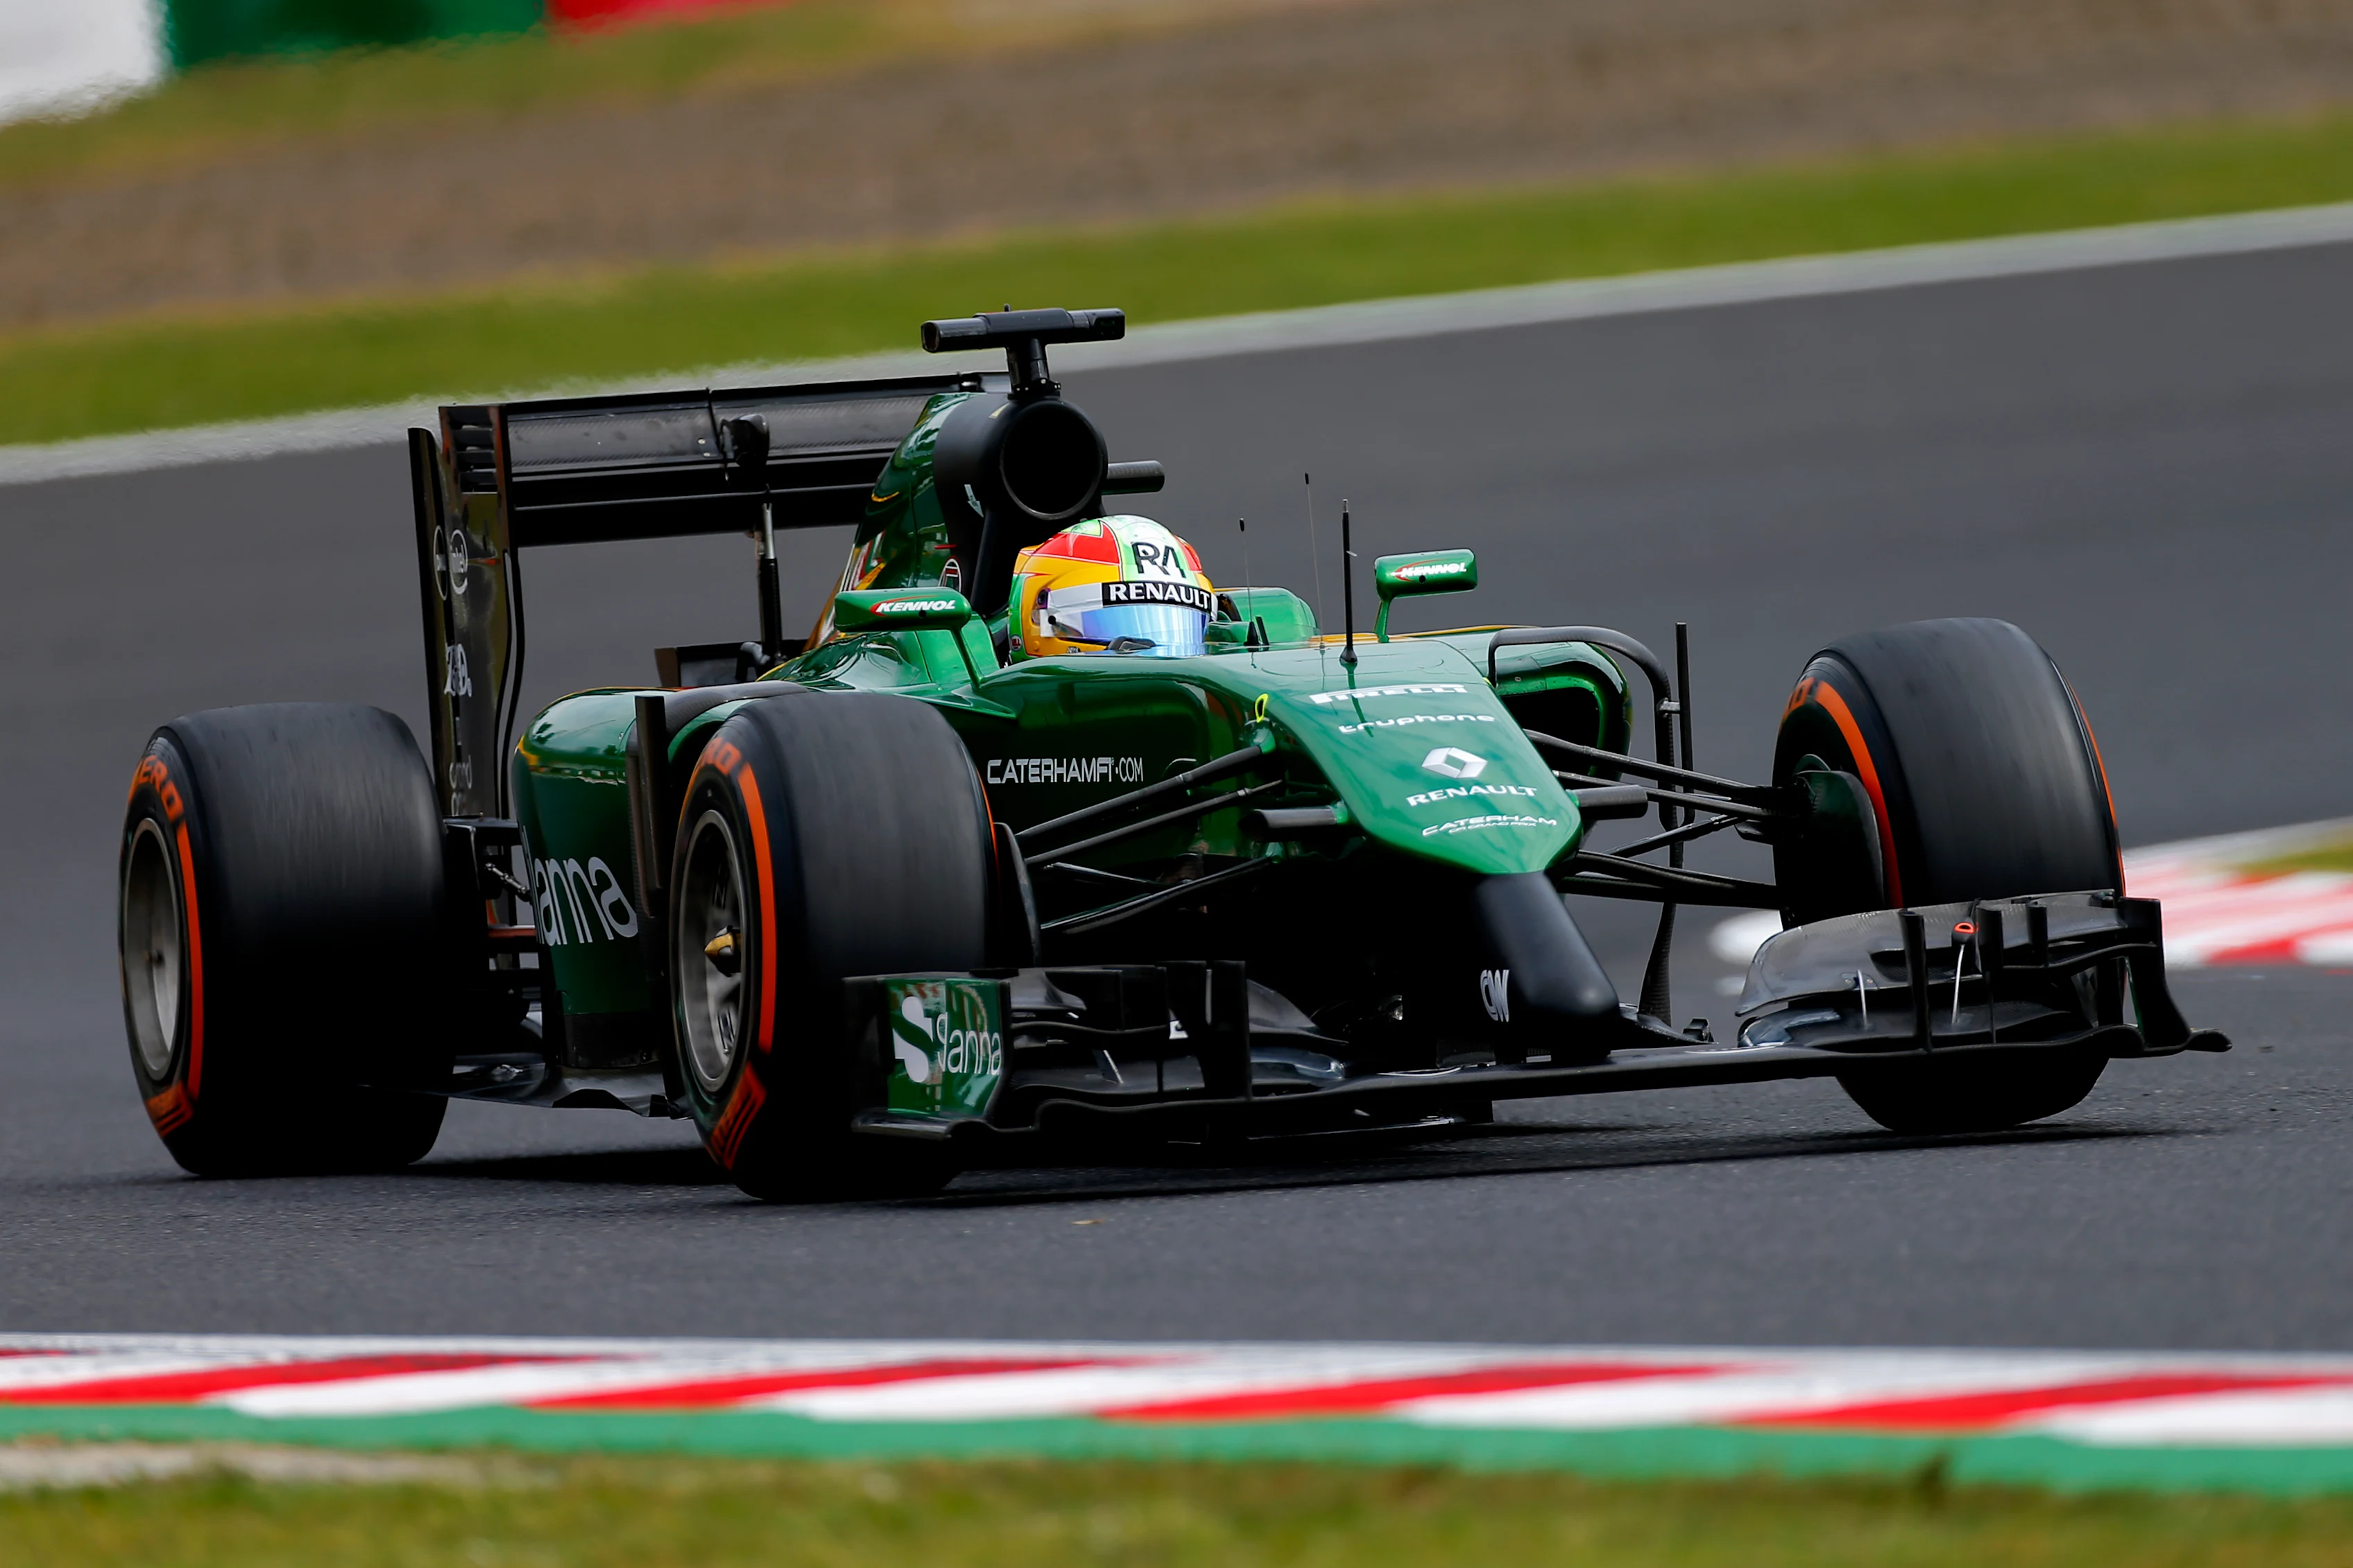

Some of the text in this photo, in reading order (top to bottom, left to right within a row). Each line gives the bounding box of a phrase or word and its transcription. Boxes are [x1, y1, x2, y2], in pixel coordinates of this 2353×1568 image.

[1400, 562, 1467, 578] KENNOL
[875, 600, 956, 612] KENNOL
[1109, 583, 1210, 610] RENAULT
[1309, 684, 1468, 704] PIRELLI
[1339, 714, 1495, 733] truphone
[1406, 785, 1537, 807] RENAULT
[1422, 815, 1557, 836] CATERHAM
